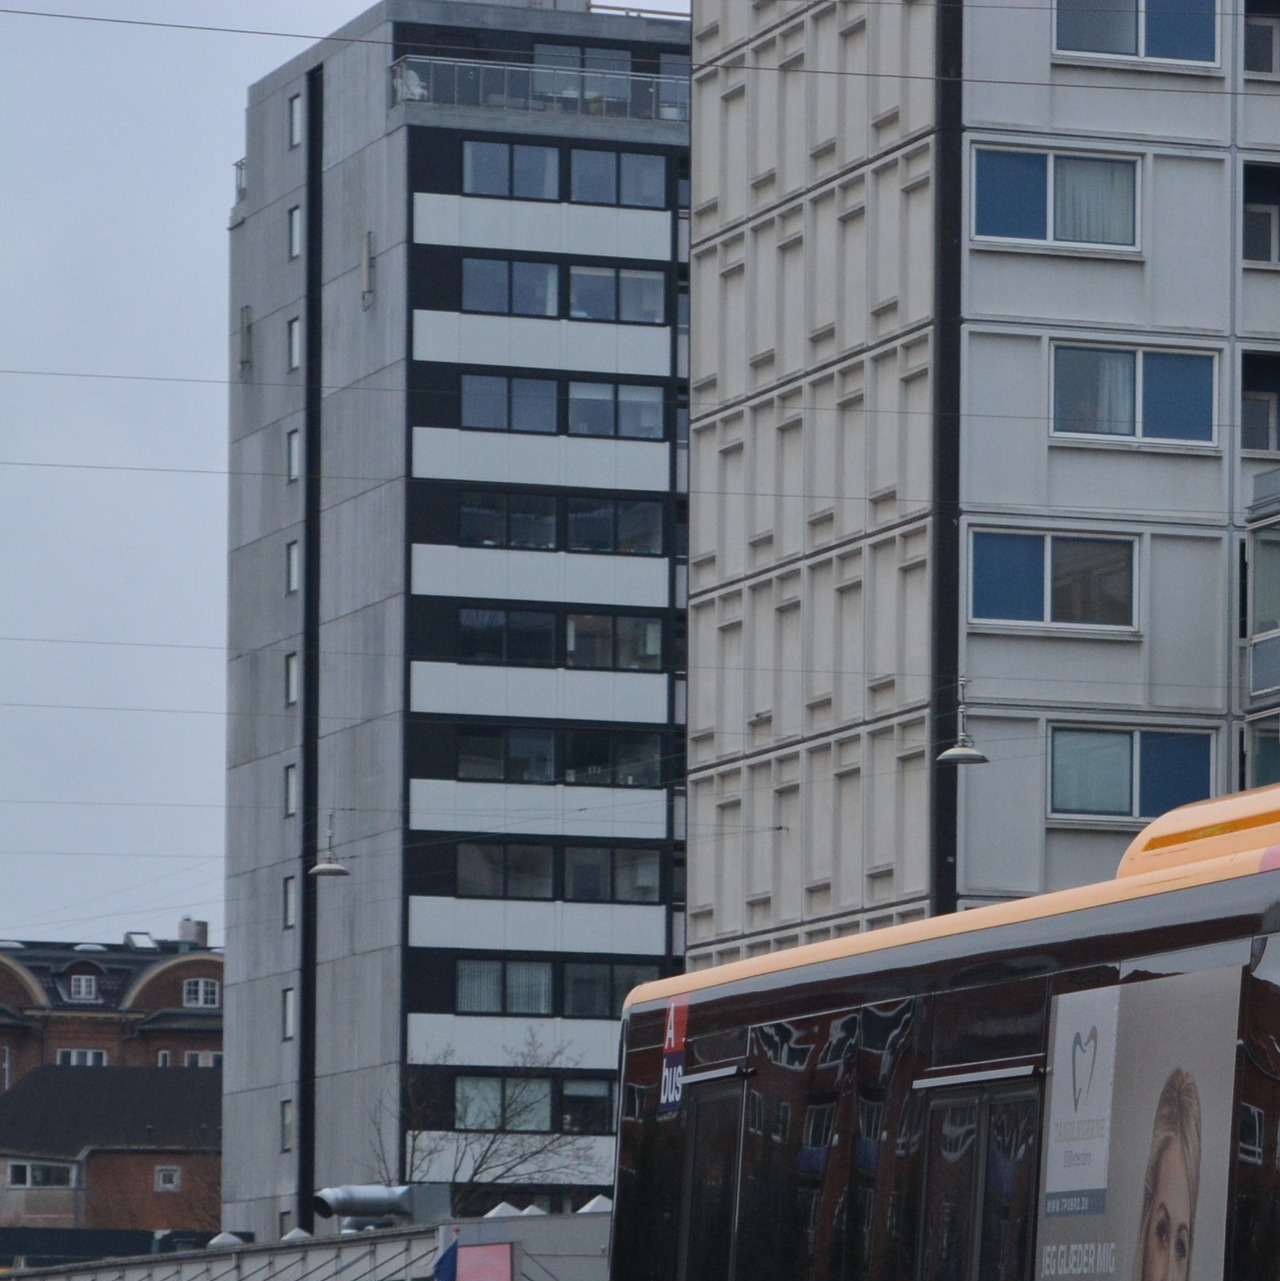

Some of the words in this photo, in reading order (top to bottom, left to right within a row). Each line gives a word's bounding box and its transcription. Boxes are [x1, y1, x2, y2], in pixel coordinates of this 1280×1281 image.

[664, 1002, 675, 1050] A
[660, 1058, 683, 1104] bus
[1041, 1245, 1057, 1278] JEG
[1057, 1243, 1096, 1276] GLÆDER
[1097, 1242, 1116, 1275] MIG
